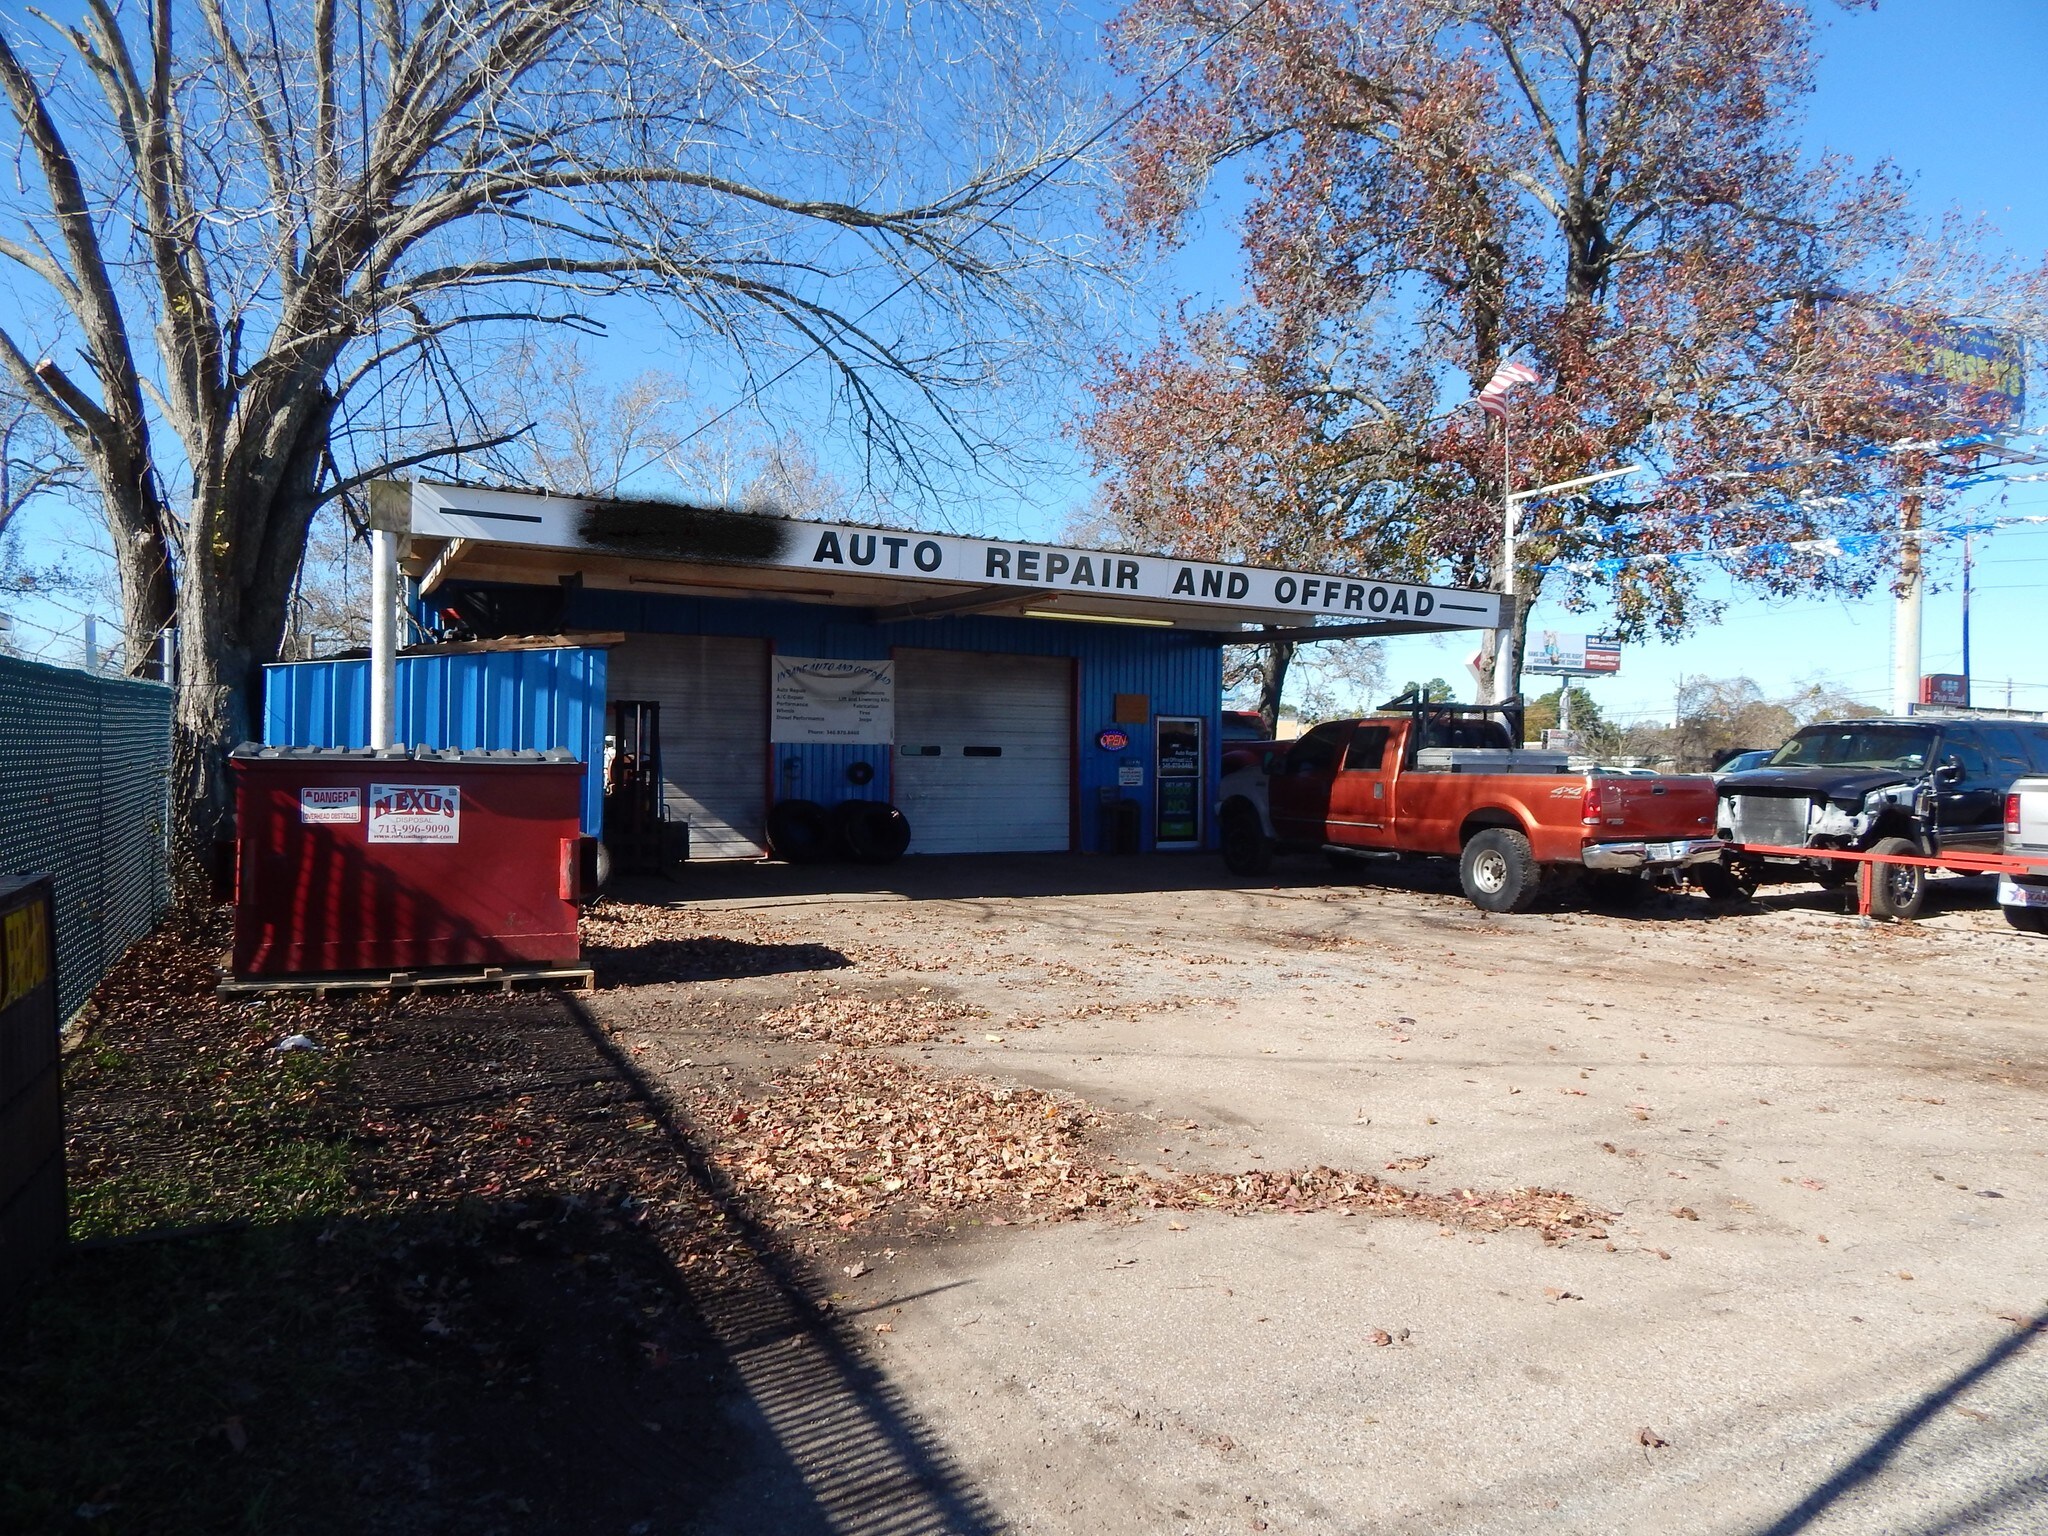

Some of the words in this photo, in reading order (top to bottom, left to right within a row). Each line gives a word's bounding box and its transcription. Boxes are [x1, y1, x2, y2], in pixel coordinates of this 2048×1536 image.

[813, 531, 942, 572] AUTO
[985, 547, 1140, 590] REPAIR
[1172, 567, 1250, 600] AND
[1274, 577, 1435, 617] OFFROAD
[777, 664, 808, 683] INSANE
[809, 662, 835, 672] AUTO
[836, 663, 853, 672] AND
[853, 666, 891, 685] OFFROAD
[1100, 734, 1127, 746] OPEN
[1551, 786, 1584, 795] 4x4
[313, 791, 349, 804] DANGER
[374, 787, 455, 819] NEXUS
[378, 824, 450, 834] 713-996-9090
